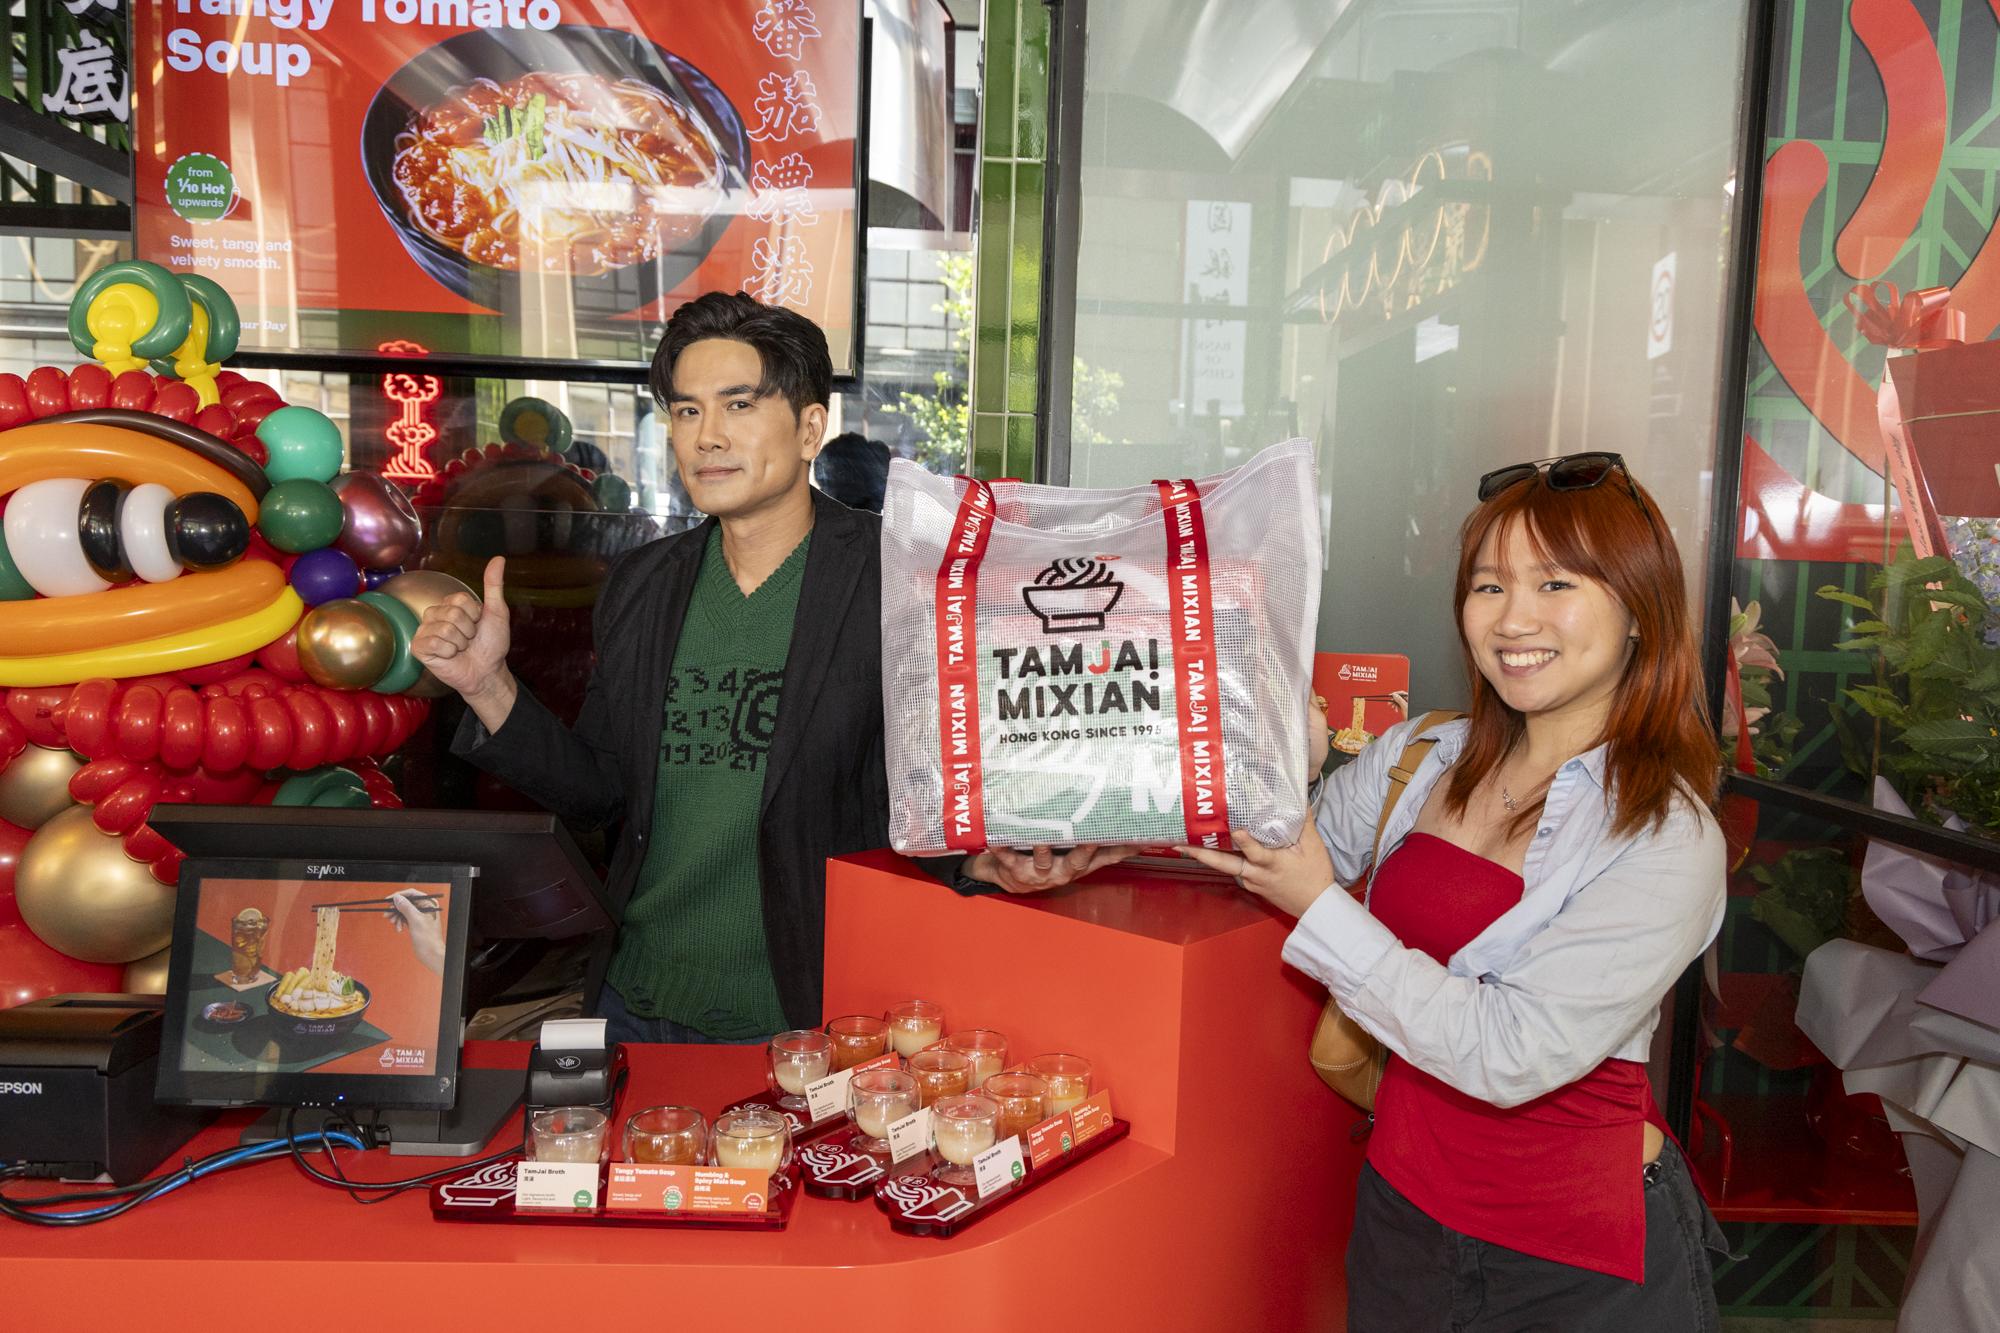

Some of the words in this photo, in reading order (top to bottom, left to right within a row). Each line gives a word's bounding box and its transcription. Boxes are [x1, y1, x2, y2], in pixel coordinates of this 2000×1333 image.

[42, 0, 129, 122] 底
[167, 28, 311, 87] Soup
[188, 166, 214, 178] from
[201, 182, 225, 195] Hot
[178, 197, 225, 209] upwards
[170, 234, 219, 250] Sweet,
[222, 236, 262, 252] tangy
[266, 239, 292, 252] and
[170, 254, 221, 270] velvety
[223, 257, 281, 270] smooth.
[1175, 501, 1195, 538] MIXIAN
[1181, 574, 1202, 642] MIXIAN
[685, 667, 709, 694] 3
[717, 667, 740, 698] 4
[998, 680, 1161, 721] MIXIAN
[950, 684, 969, 755] MIXIAN
[1000, 732, 1038, 745] HONG
[1043, 729, 1081, 741] KONG
[1086, 726, 1128, 739] SINCE
[1192, 740, 1214, 816] MIXIAN
[306, 864, 345, 880] SENOR
[395, 1057, 425, 1065] MIXIAN
[0, 1081, 43, 1095] EPSON
[614, 1167, 634, 1175] Tangy
